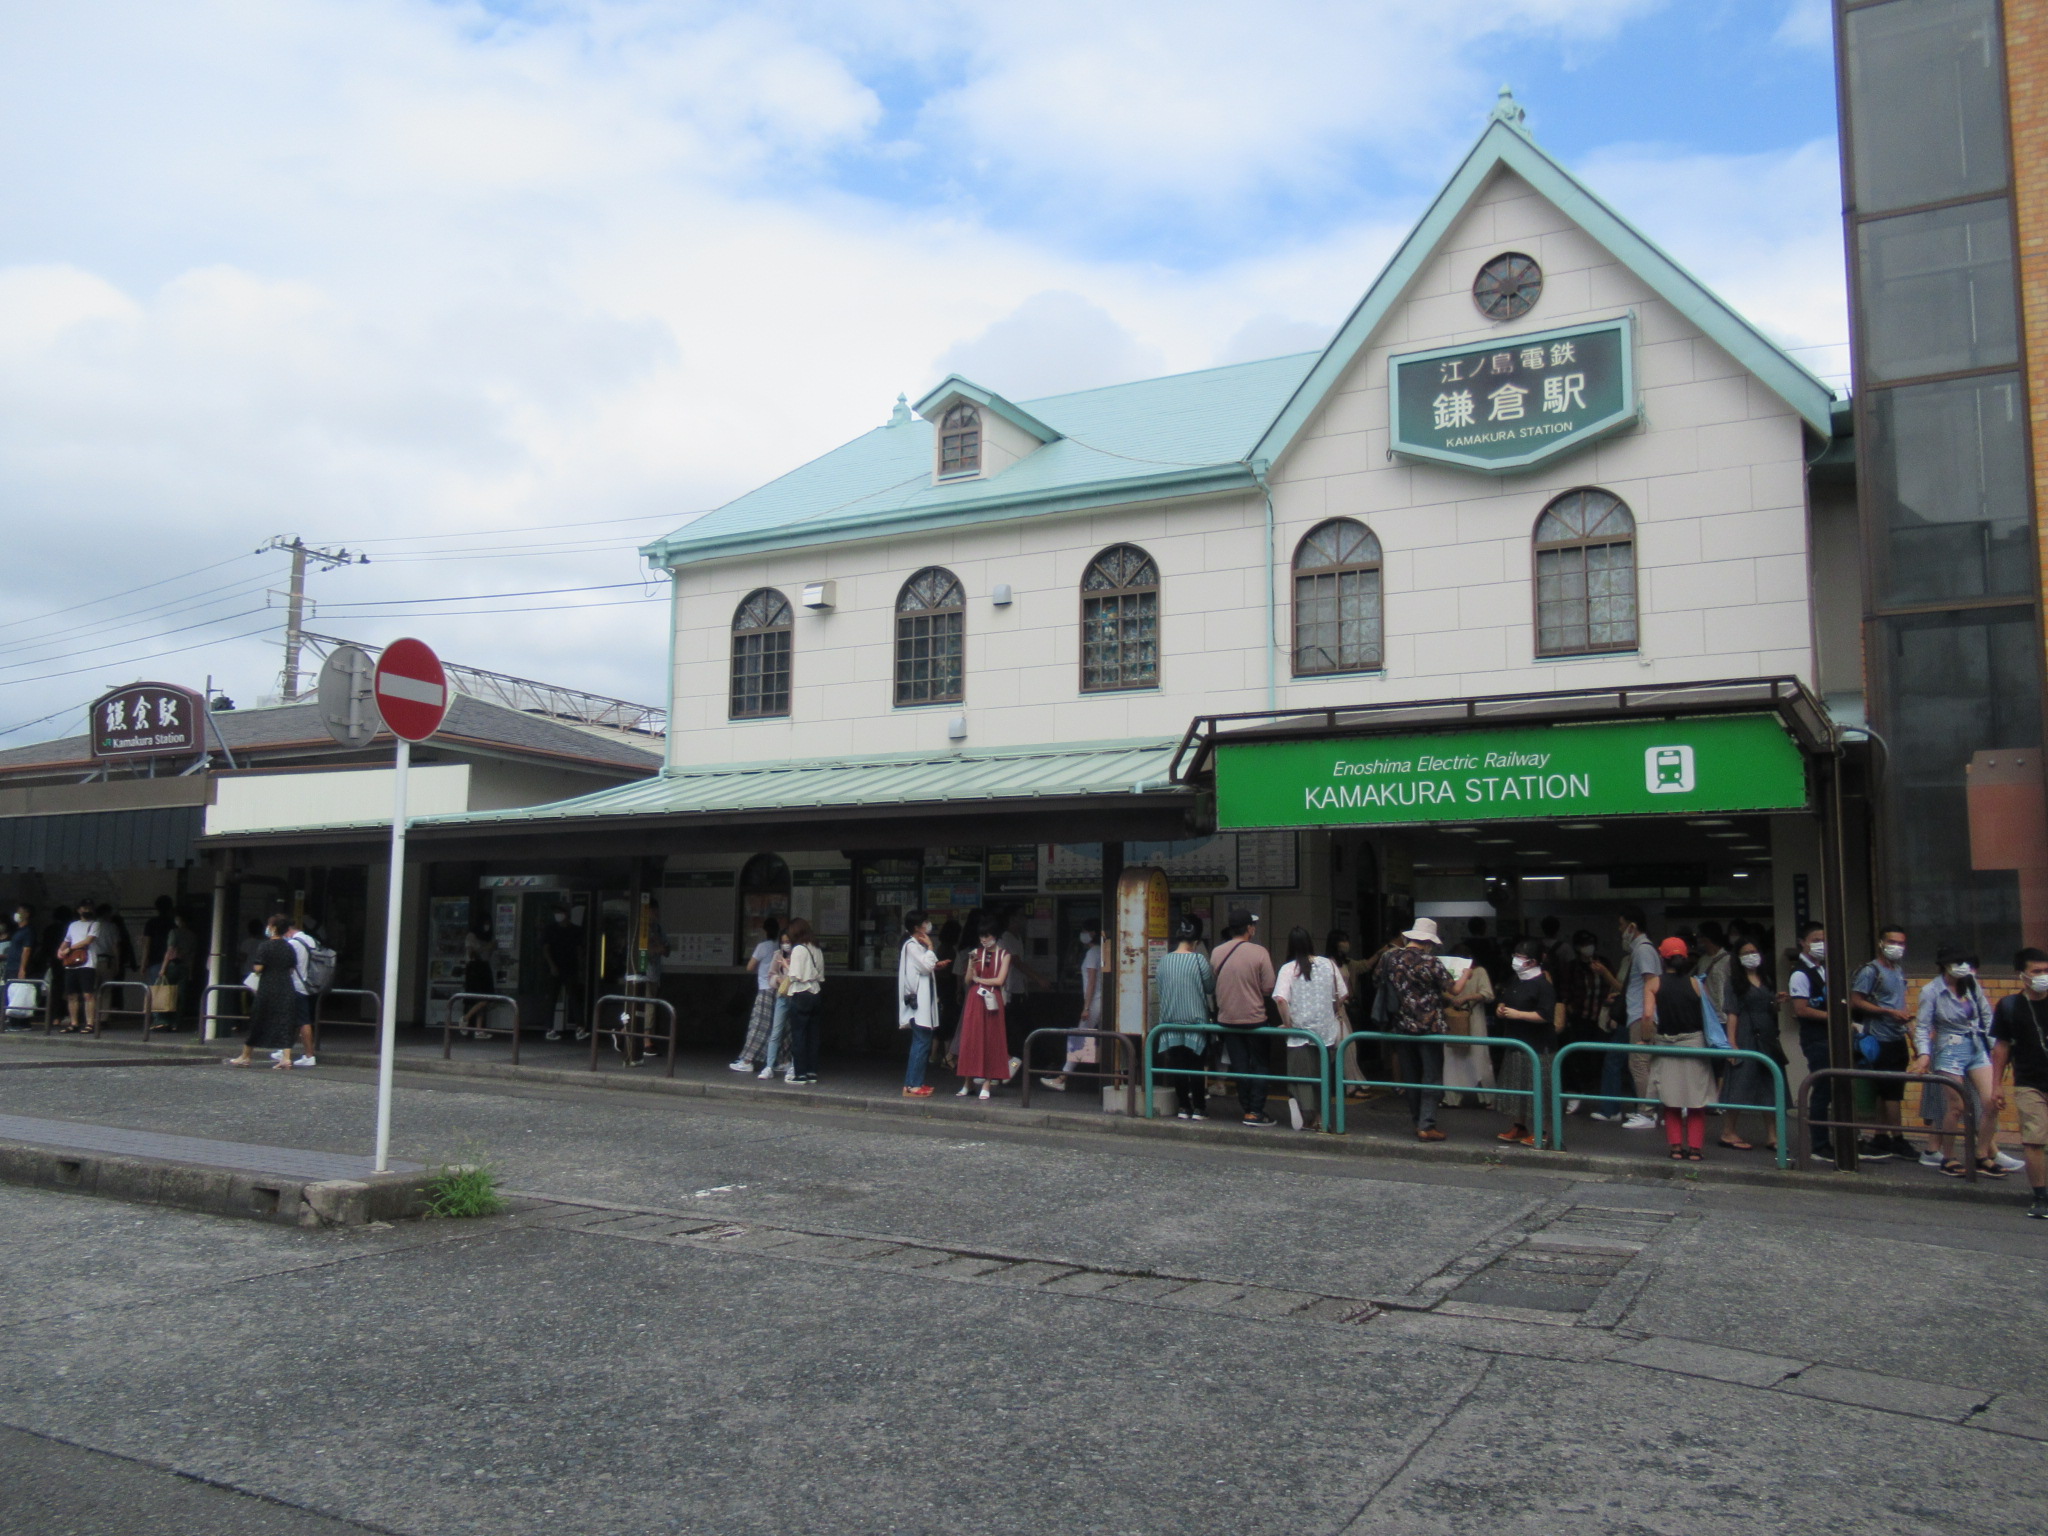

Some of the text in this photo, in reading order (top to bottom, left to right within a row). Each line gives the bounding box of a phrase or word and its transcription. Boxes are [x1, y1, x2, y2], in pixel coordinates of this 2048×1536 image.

[1441, 342, 1576, 383] 江ノ島電鉄
[1432, 373, 1587, 431] 鎌倉駅
[1446, 421, 1573, 448] KAMAKURA STATION
[113, 736, 153, 748] Kamakura
[155, 732, 184, 745] Station
[1332, 751, 1551, 777] Enoshima Electric Railway
[1304, 773, 1590, 810] KAMAKURA STATION
[1150, 890, 1166, 903] TAXI
